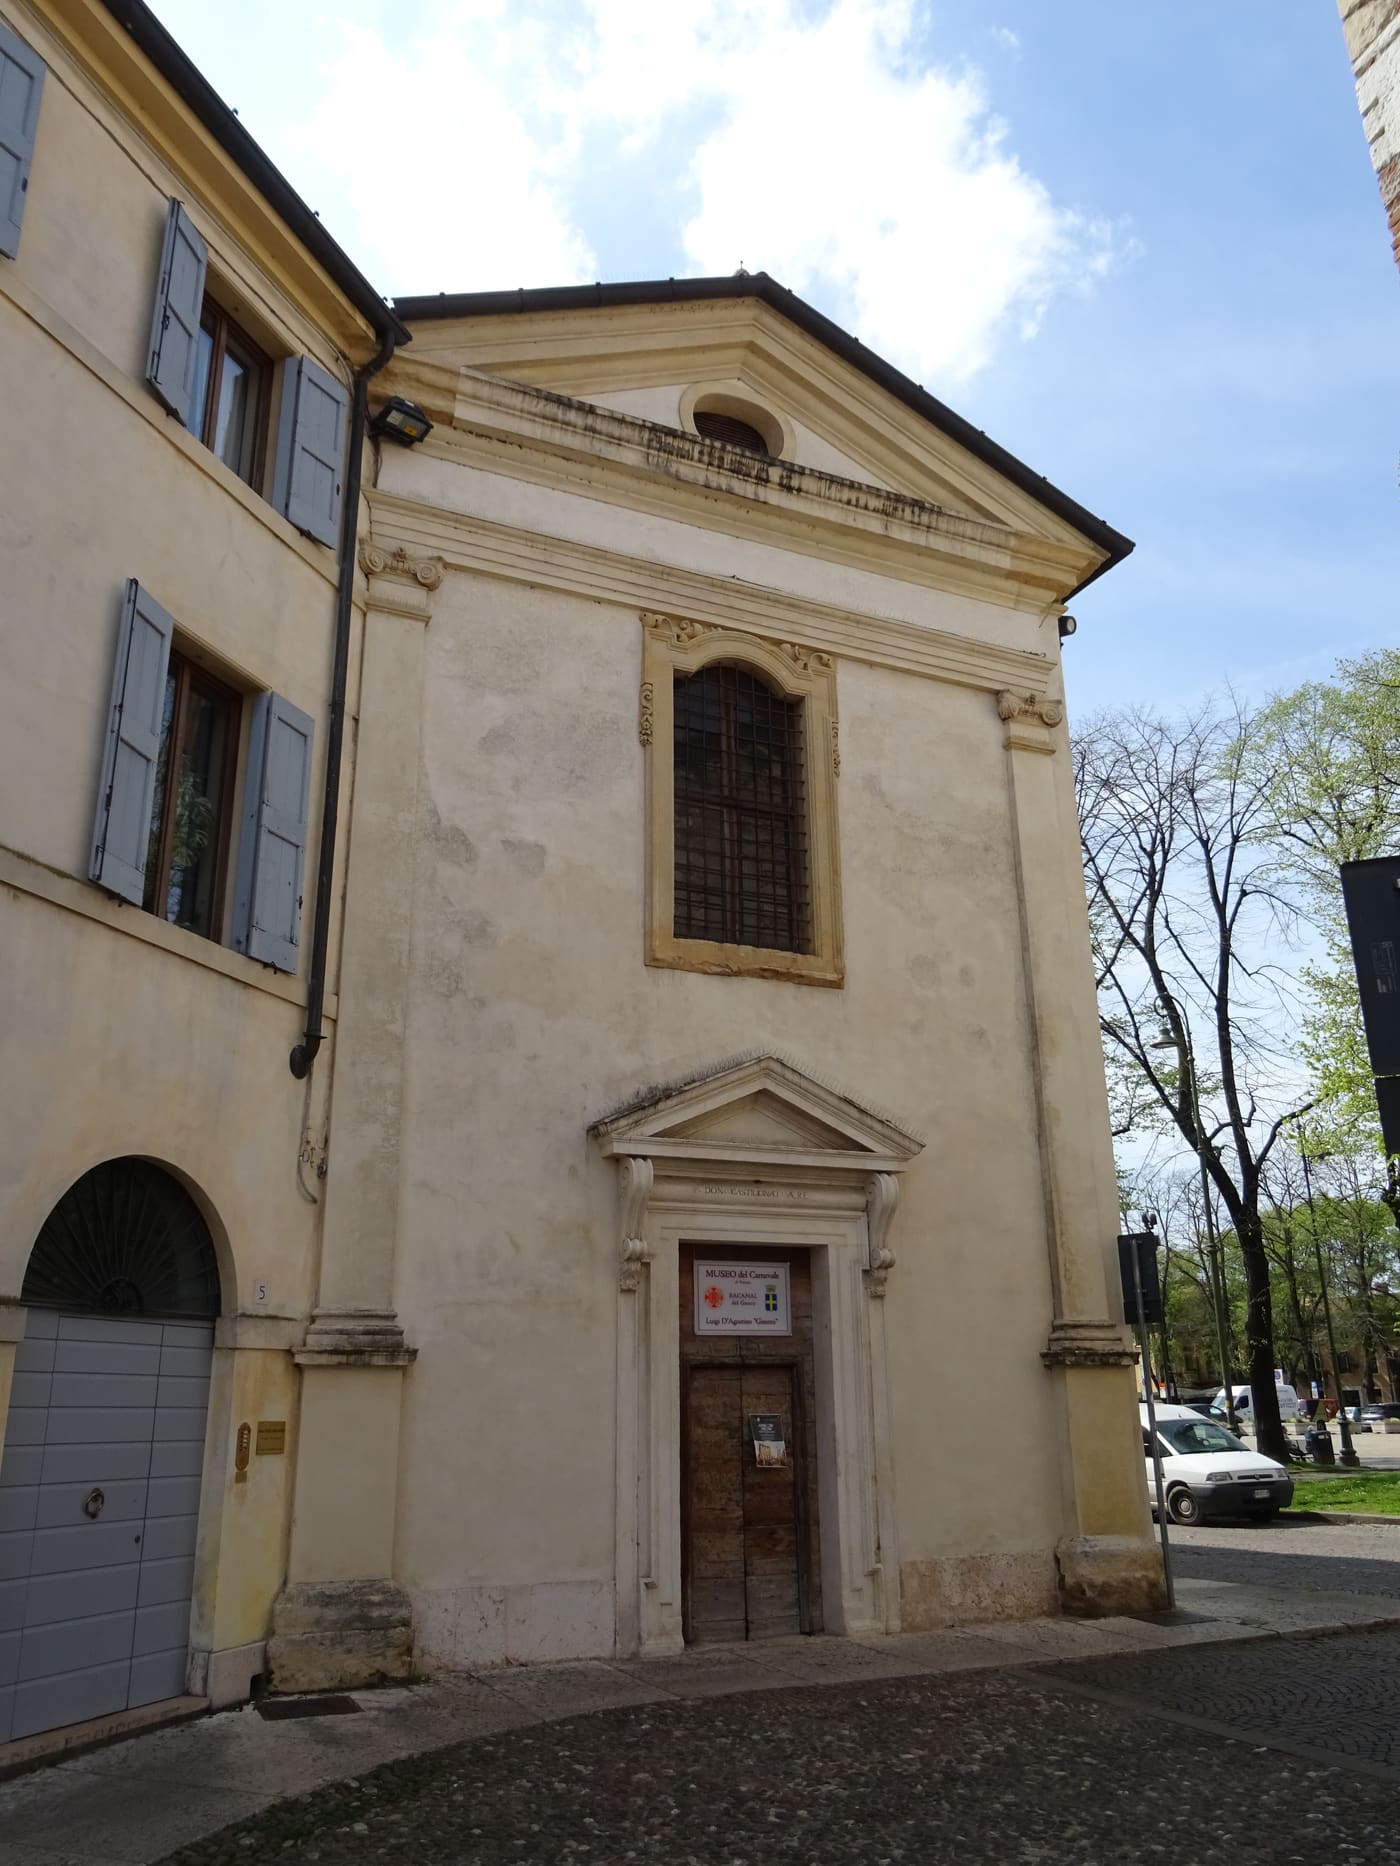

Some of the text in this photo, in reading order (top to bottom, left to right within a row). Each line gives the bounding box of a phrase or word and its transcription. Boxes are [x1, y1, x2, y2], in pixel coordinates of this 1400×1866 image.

[705, 1269, 737, 1278] MUSEO
[738, 1270, 747, 1279] del
[259, 1285, 265, 1300] 5
